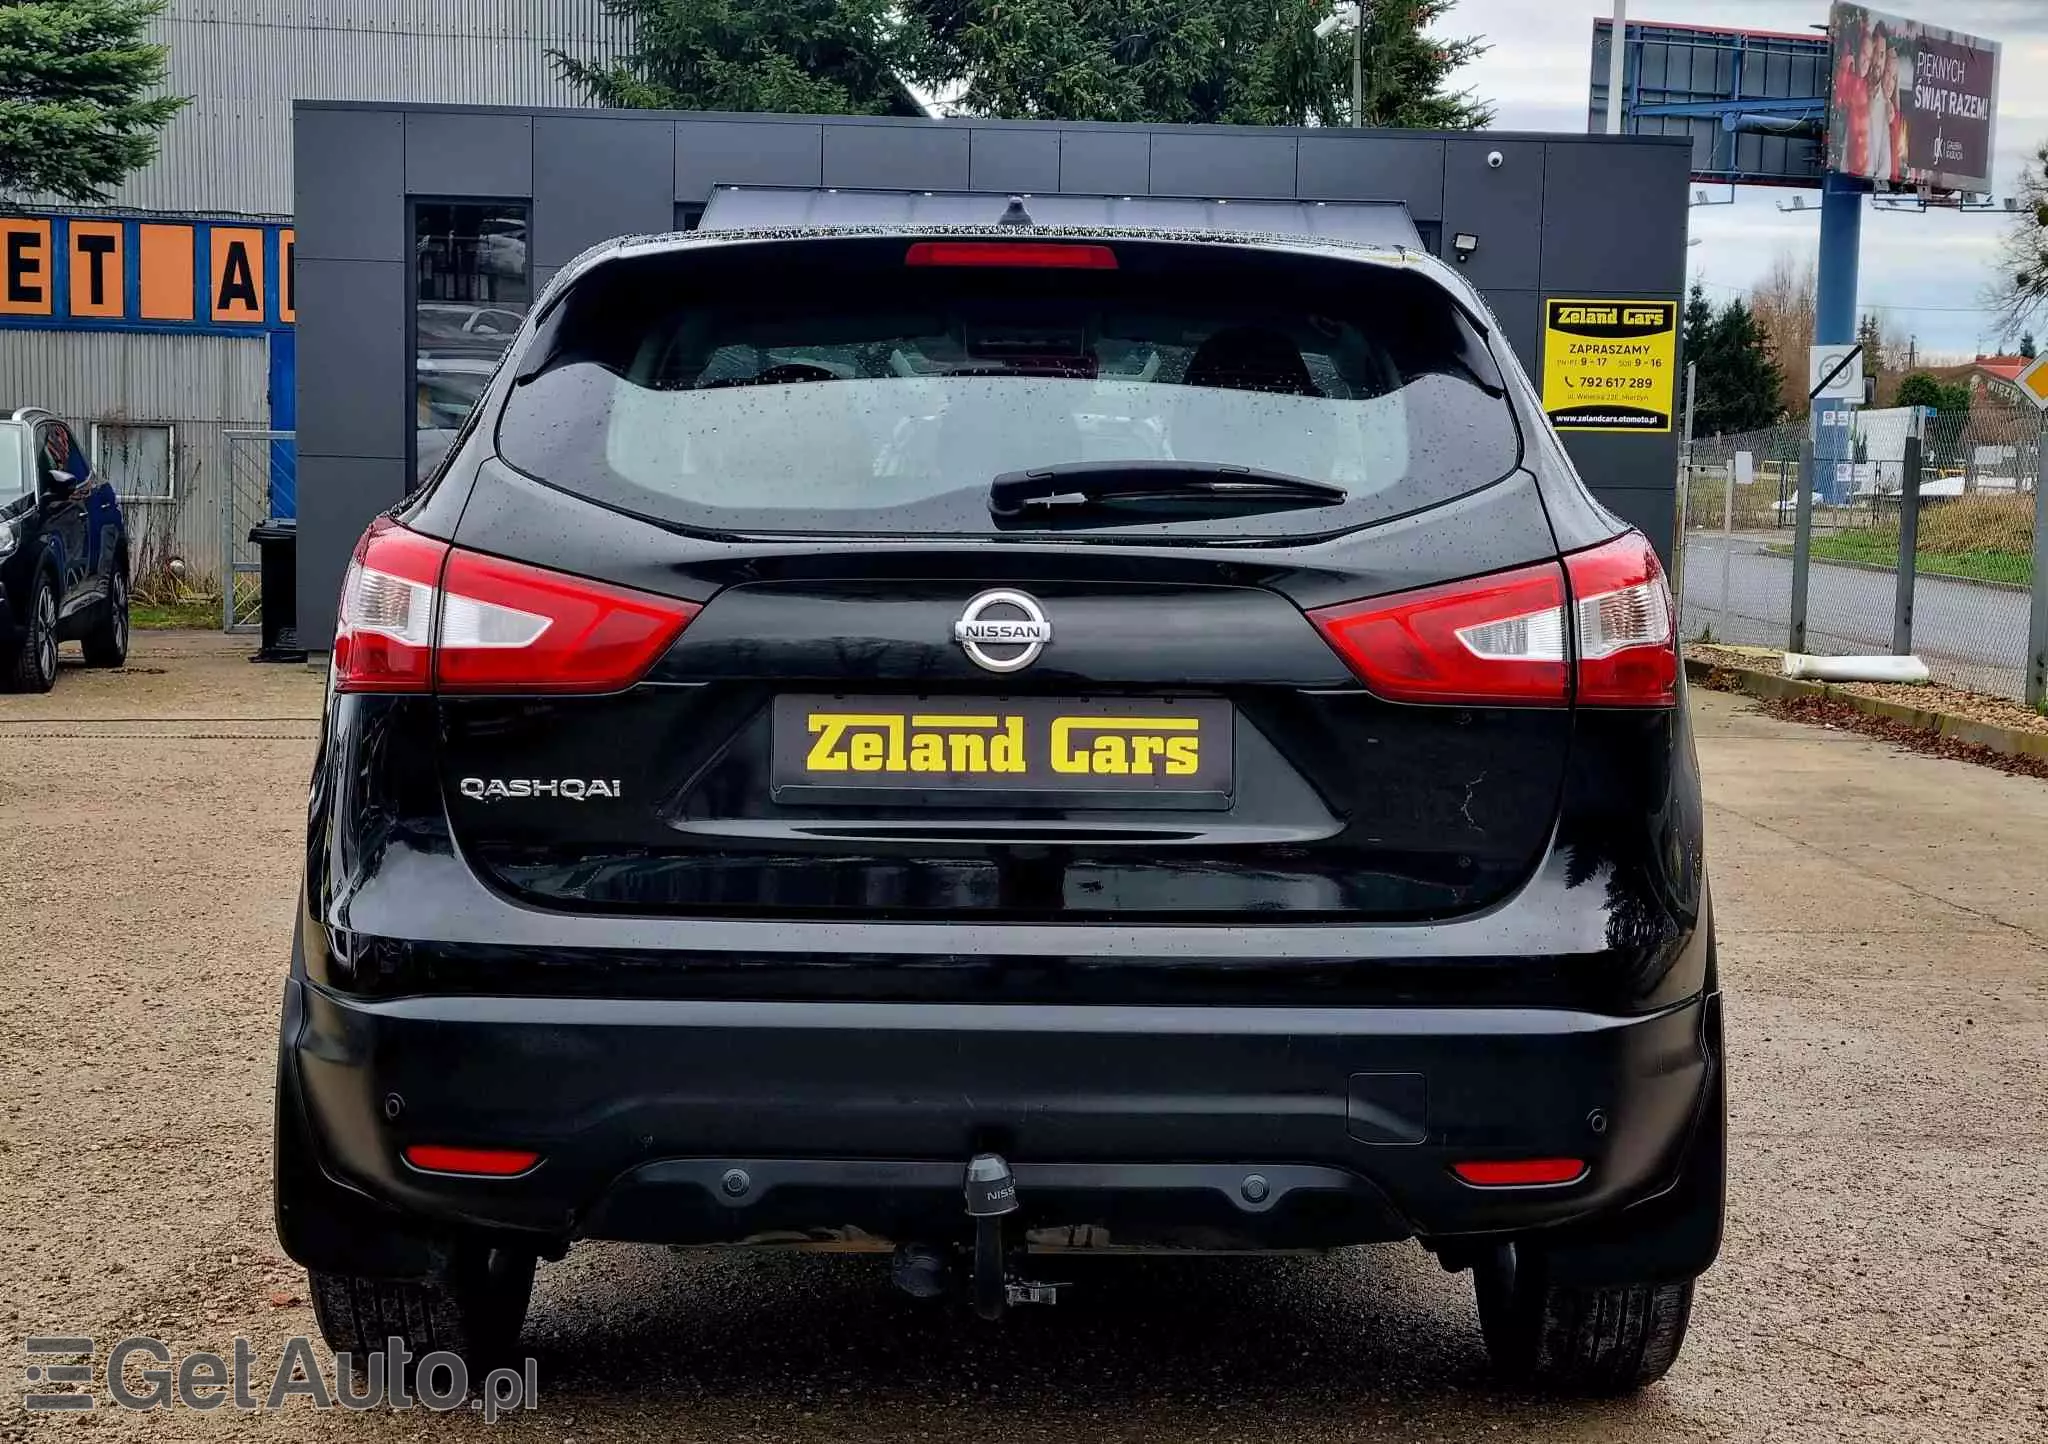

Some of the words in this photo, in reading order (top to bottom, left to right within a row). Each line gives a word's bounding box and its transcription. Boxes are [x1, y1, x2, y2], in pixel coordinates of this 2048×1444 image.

[1916, 51, 1966, 84] PIĘKNYCH
[1914, 79, 1947, 119] ŚWIĄT
[1949, 92, 1989, 121] RAZEM!
[217, 241, 296, 311] A
[1558, 307, 1618, 325] Zeland
[1623, 308, 1664, 326] Cars
[1569, 344, 1651, 355] ZAPRASZAMY
[1580, 358, 1587, 366] 9
[1597, 357, 1608, 367] 17
[1634, 358, 1642, 367] 9
[1651, 359, 1662, 368] 16
[1580, 377, 1602, 388] 792
[1605, 377, 1626, 388] 617
[1629, 378, 1653, 389] 289
[1556, 414, 1658, 424] www.zelandcars.otomoto.pl
[965, 626, 1040, 638] NISSAN
[806, 713, 1027, 774] Zeland
[1051, 716, 1199, 776] Cars
